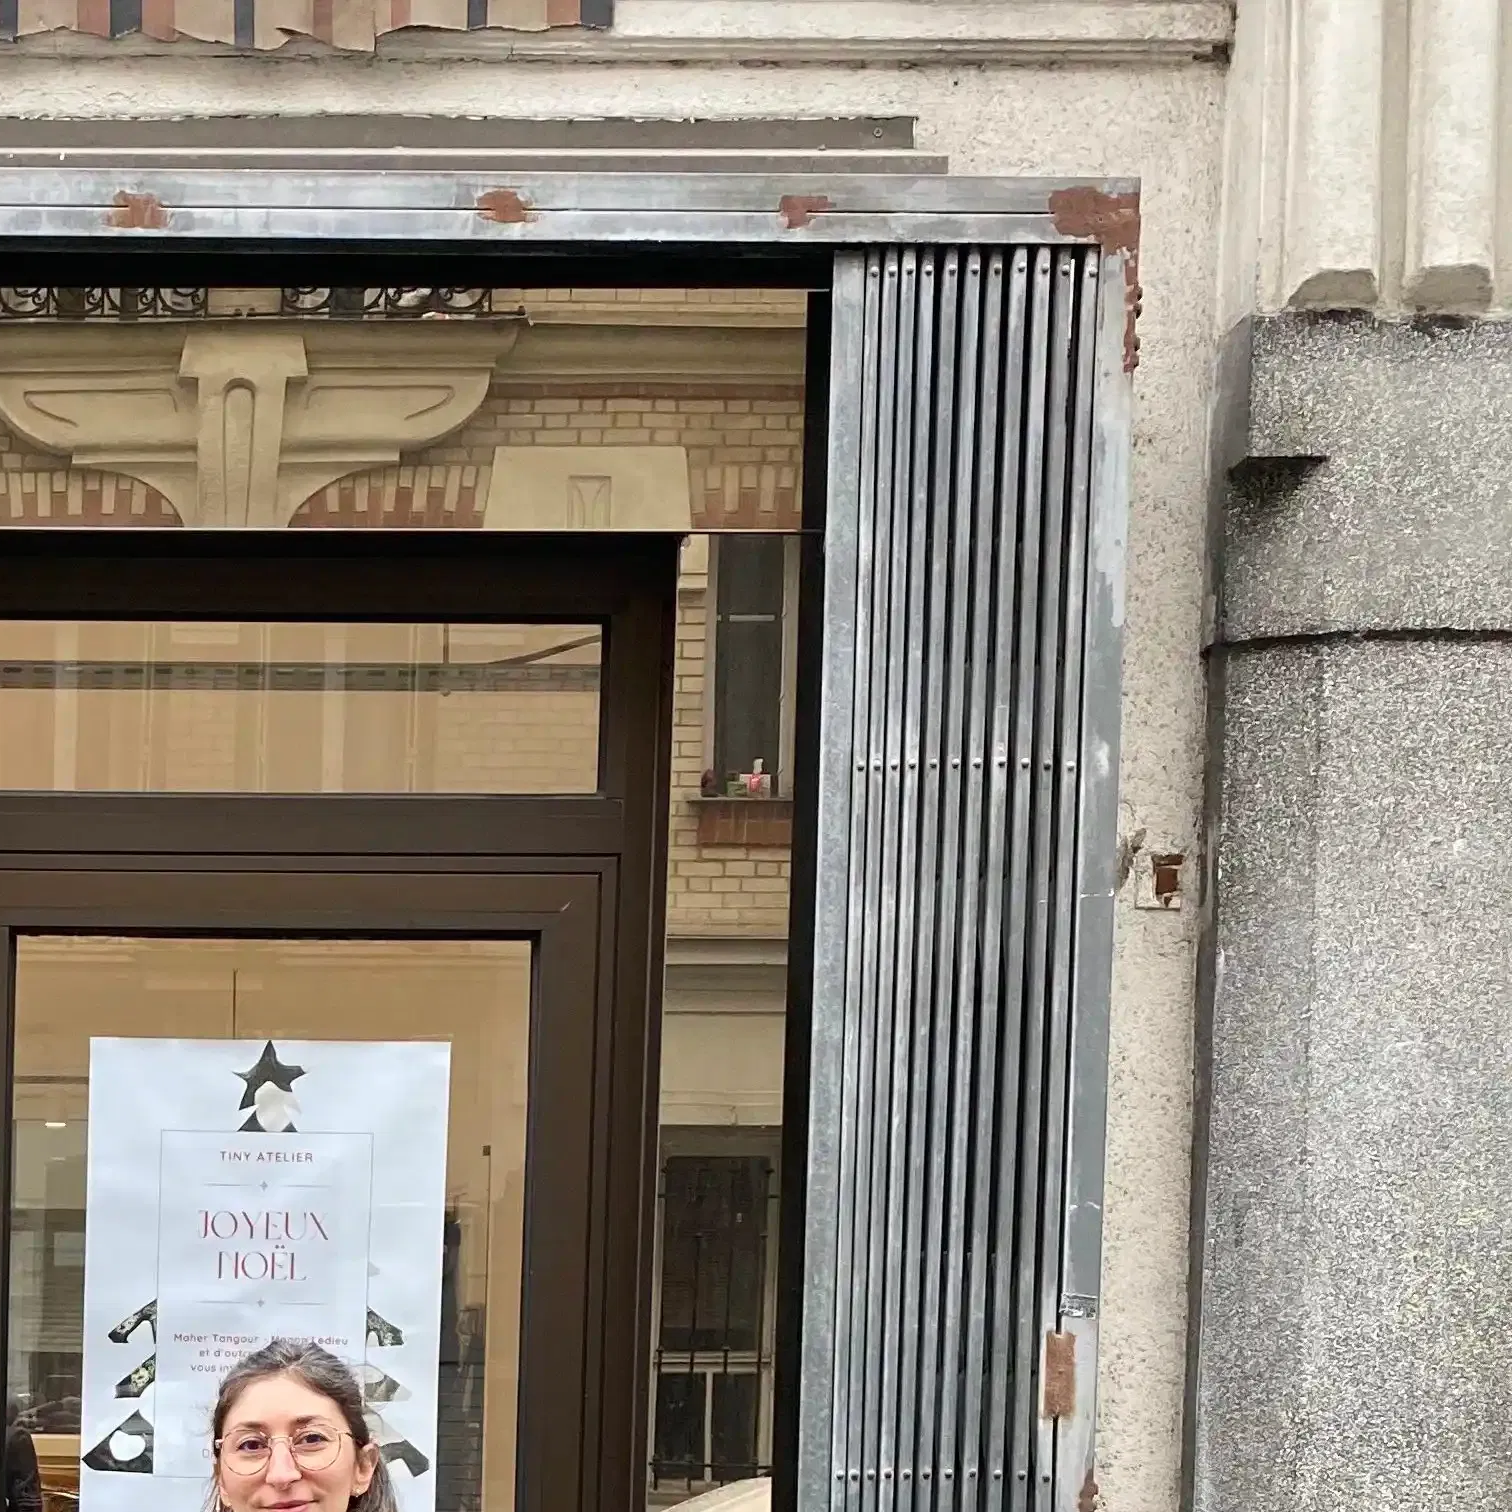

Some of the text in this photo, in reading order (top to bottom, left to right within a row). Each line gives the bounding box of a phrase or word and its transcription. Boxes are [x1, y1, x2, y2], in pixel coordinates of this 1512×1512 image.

[220, 1151, 313, 1163] TINY ATELIER
[197, 1209, 329, 1241] JOYEUX
[218, 1244, 307, 1281] NOËL
[212, 1333, 260, 1345] Tangour
[199, 1348, 210, 1358] et
[190, 1364, 216, 1373] vous
